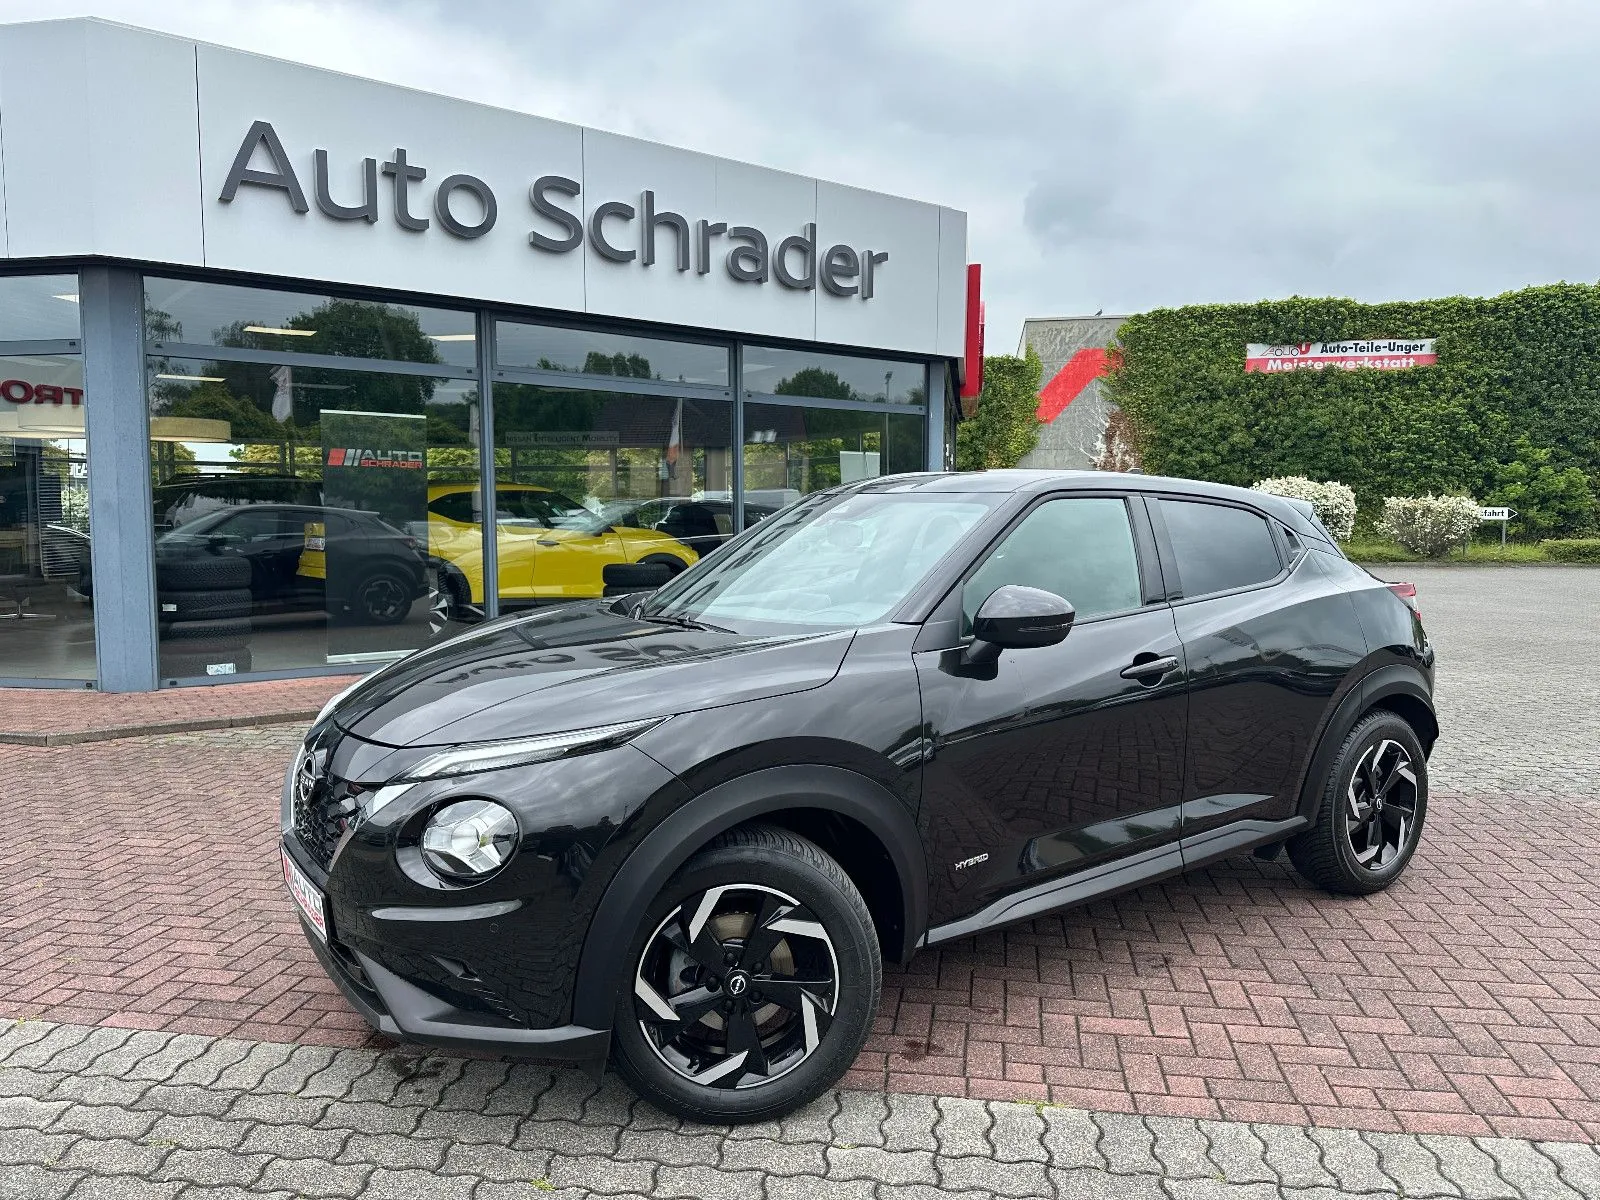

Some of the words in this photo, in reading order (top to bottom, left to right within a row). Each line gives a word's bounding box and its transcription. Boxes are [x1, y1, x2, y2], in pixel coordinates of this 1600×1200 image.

[218, 120, 498, 240] Auto
[528, 175, 889, 301] Schrader
[1320, 341, 1426, 355] Auto-Teile-Unger
[361, 449, 423, 462] AUTO
[361, 459, 423, 469] SCHRADER
[953, 852, 989, 871] HYBRID
